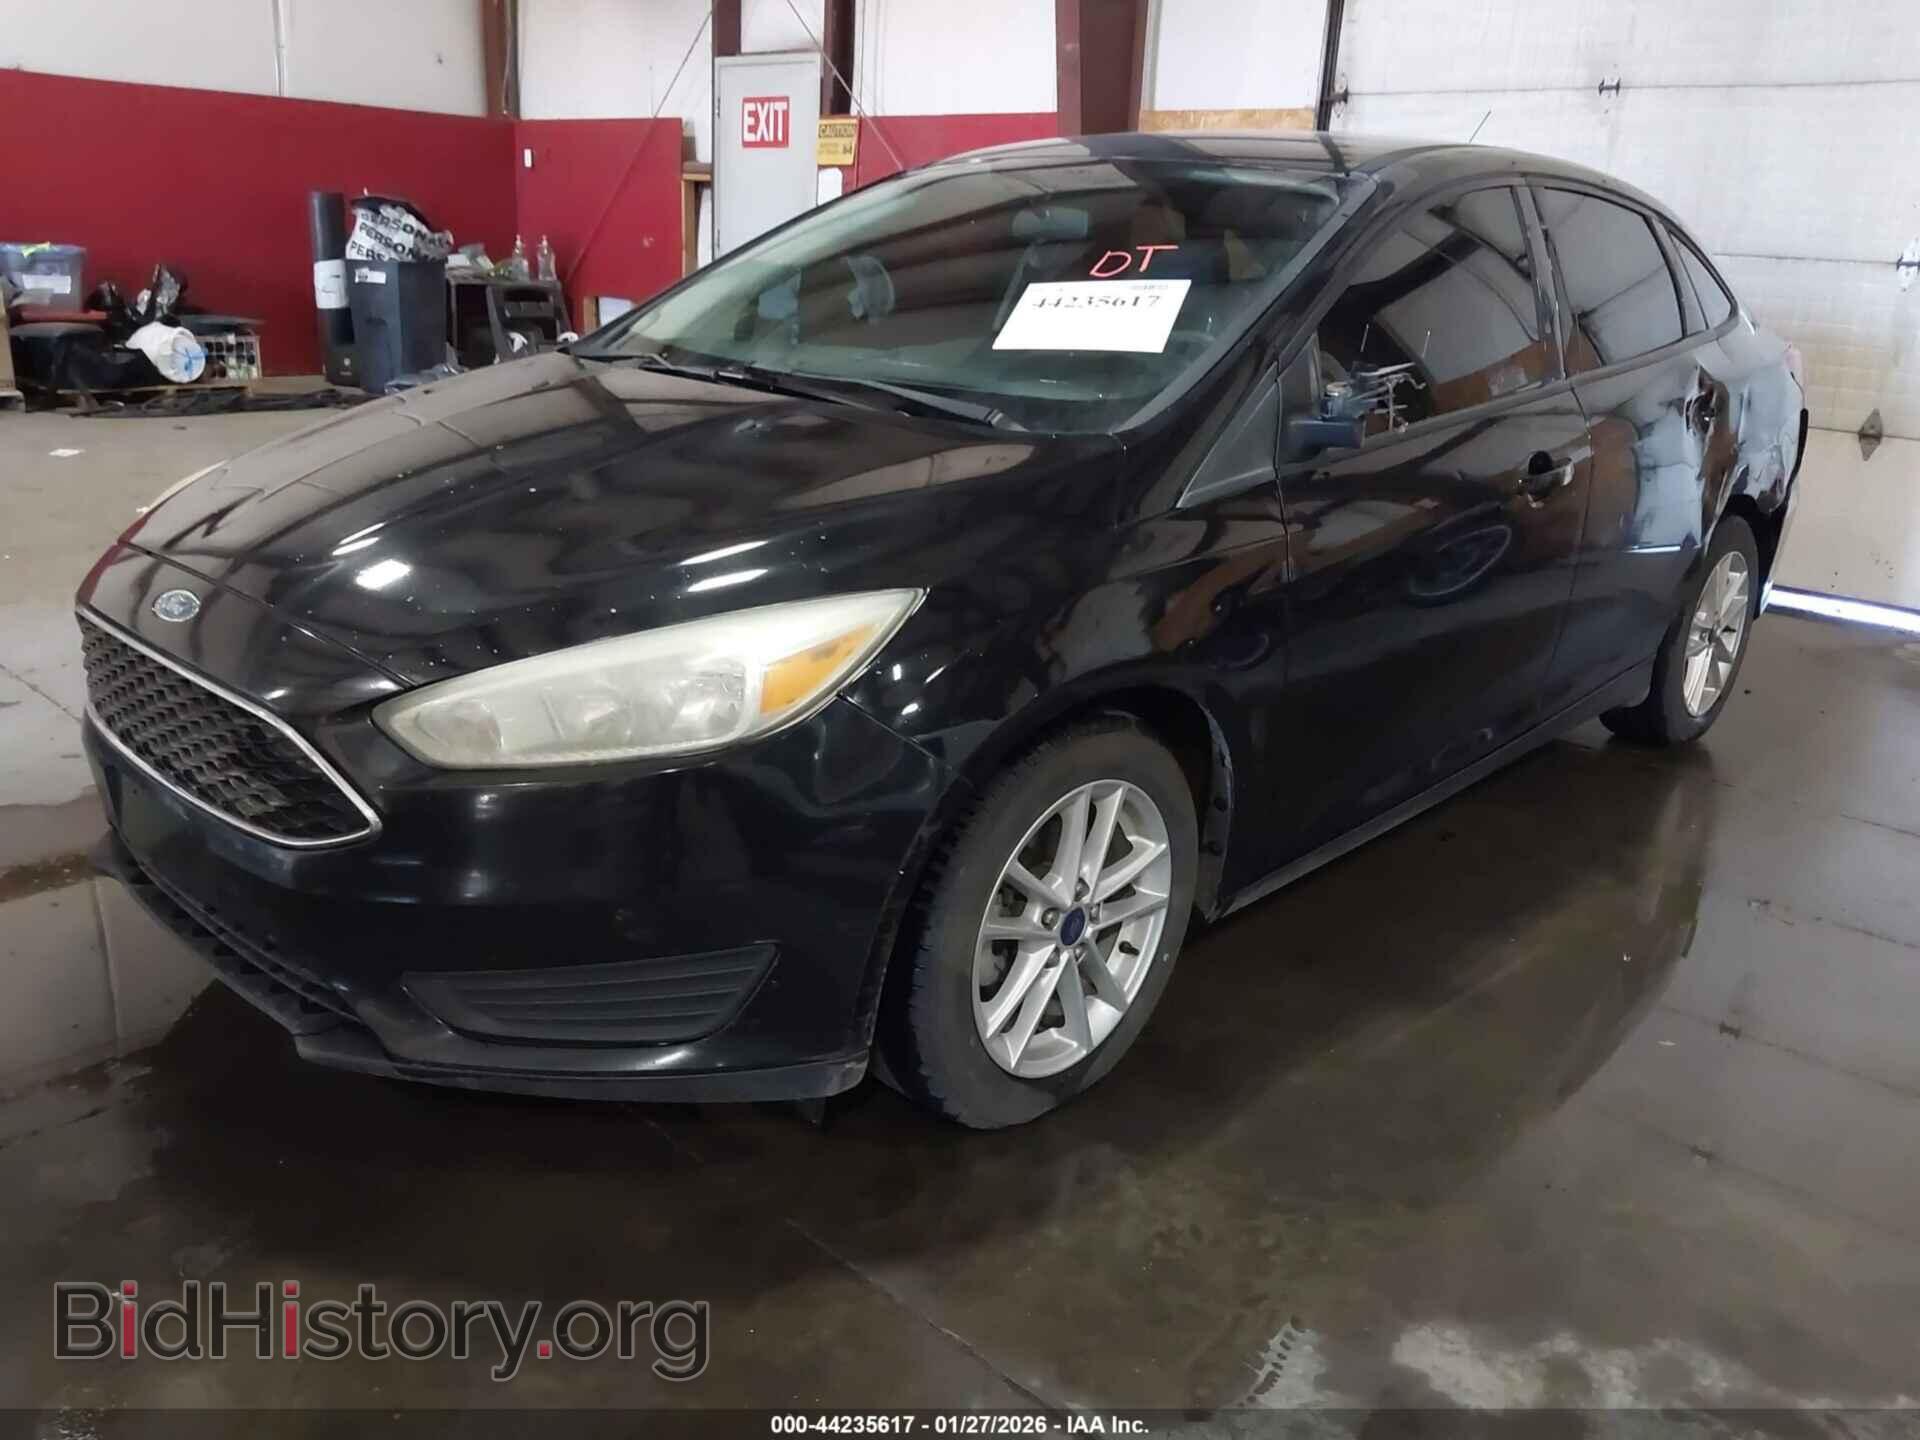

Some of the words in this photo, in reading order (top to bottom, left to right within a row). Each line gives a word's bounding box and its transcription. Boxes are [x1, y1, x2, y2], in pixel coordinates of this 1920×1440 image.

[743, 101, 788, 143] EXIT
[1089, 245, 1179, 277] DT
[1032, 295, 1161, 309] 44235617
